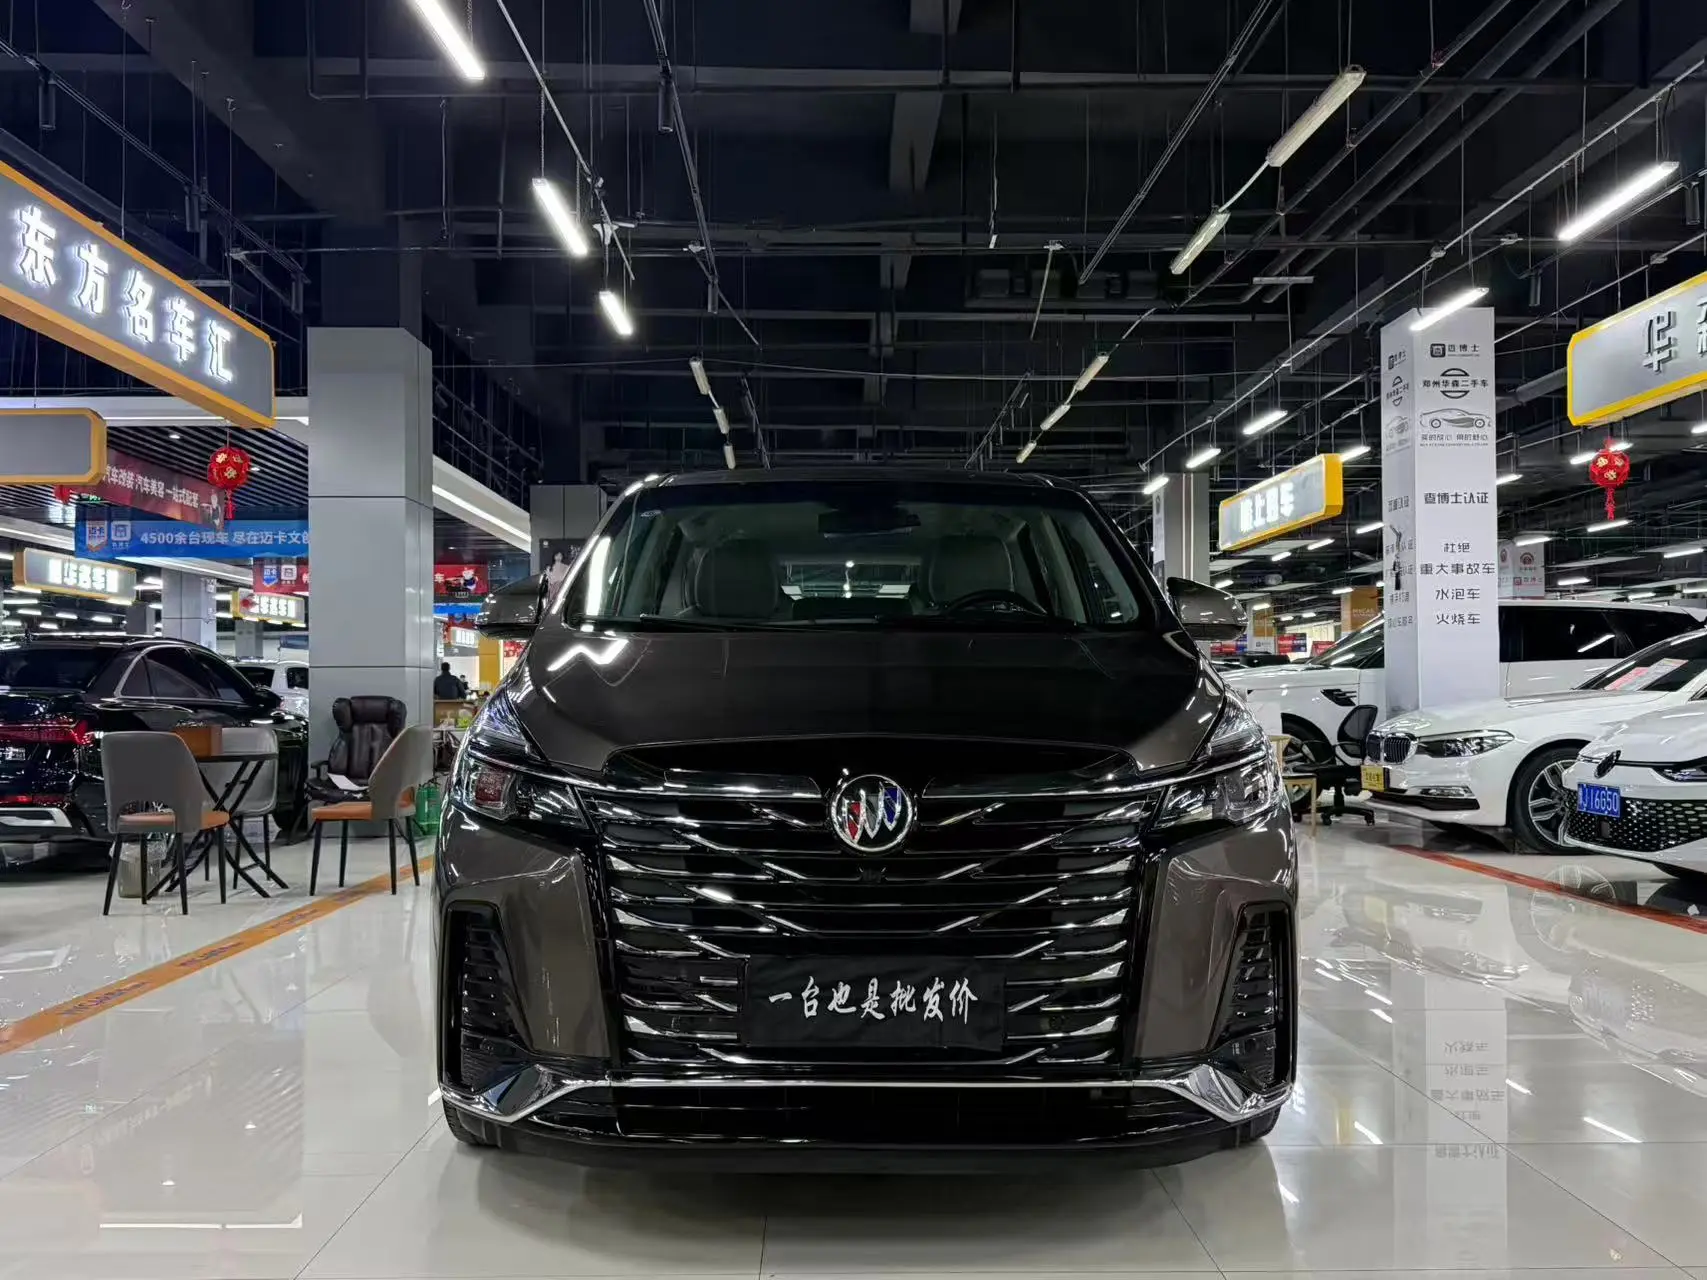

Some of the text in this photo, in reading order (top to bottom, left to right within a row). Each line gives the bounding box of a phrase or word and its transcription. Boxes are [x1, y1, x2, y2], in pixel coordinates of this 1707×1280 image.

[18, 205, 234, 384] 东方名车汇
[1424, 491, 1490, 505] 查博士认证
[140, 531, 229, 546] 4500余台现车
[1443, 542, 1471, 553] 杜绝
[1420, 563, 1496, 575] 重大事故车
[1435, 588, 1481, 600] 水泡车
[1436, 613, 1481, 625] 火烧车
[768, 975, 979, 1025] 一台也是批发价
